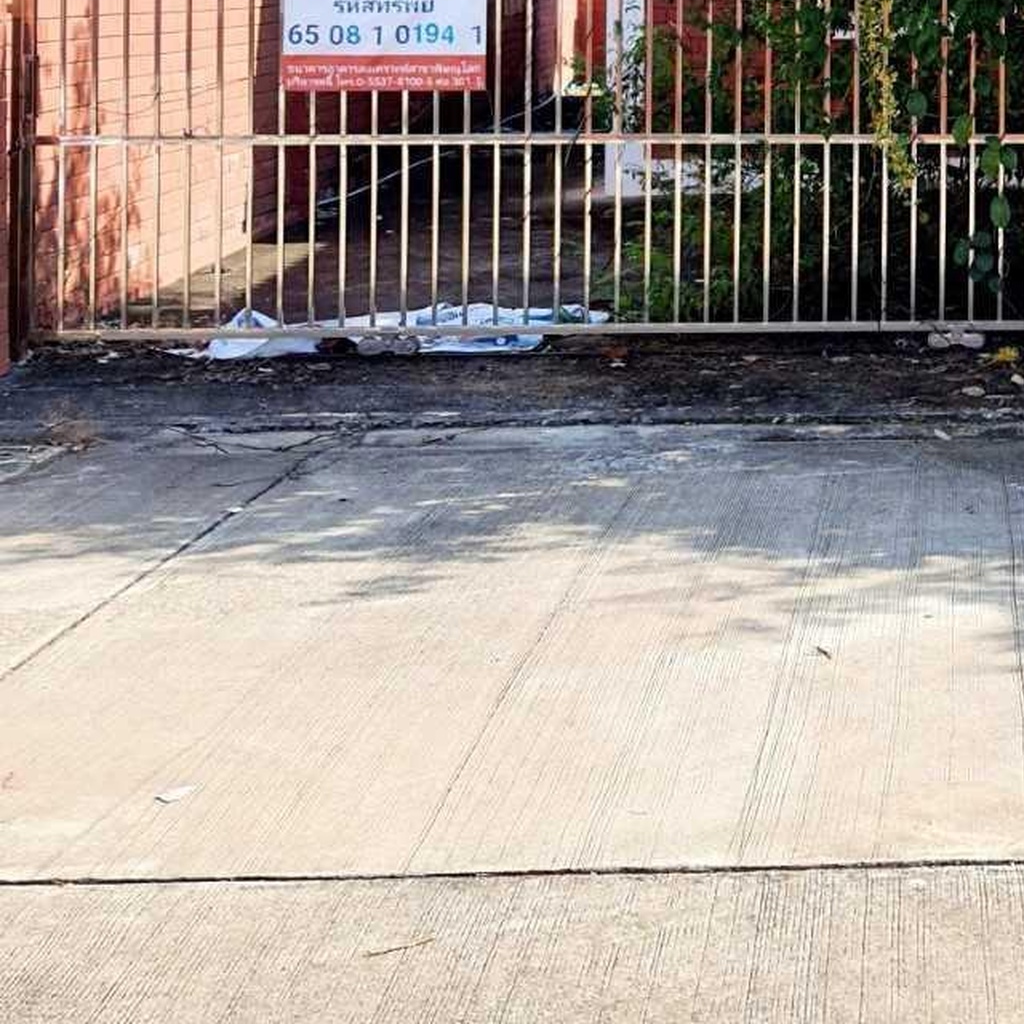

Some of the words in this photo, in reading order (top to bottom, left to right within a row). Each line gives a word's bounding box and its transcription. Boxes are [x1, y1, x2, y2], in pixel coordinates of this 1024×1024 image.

[288, 24, 319, 45] 65
[329, 25, 361, 45] 08
[373, 26, 383, 45] 1
[395, 23, 454, 45] 0194
[471, 25, 481, 45] 1
